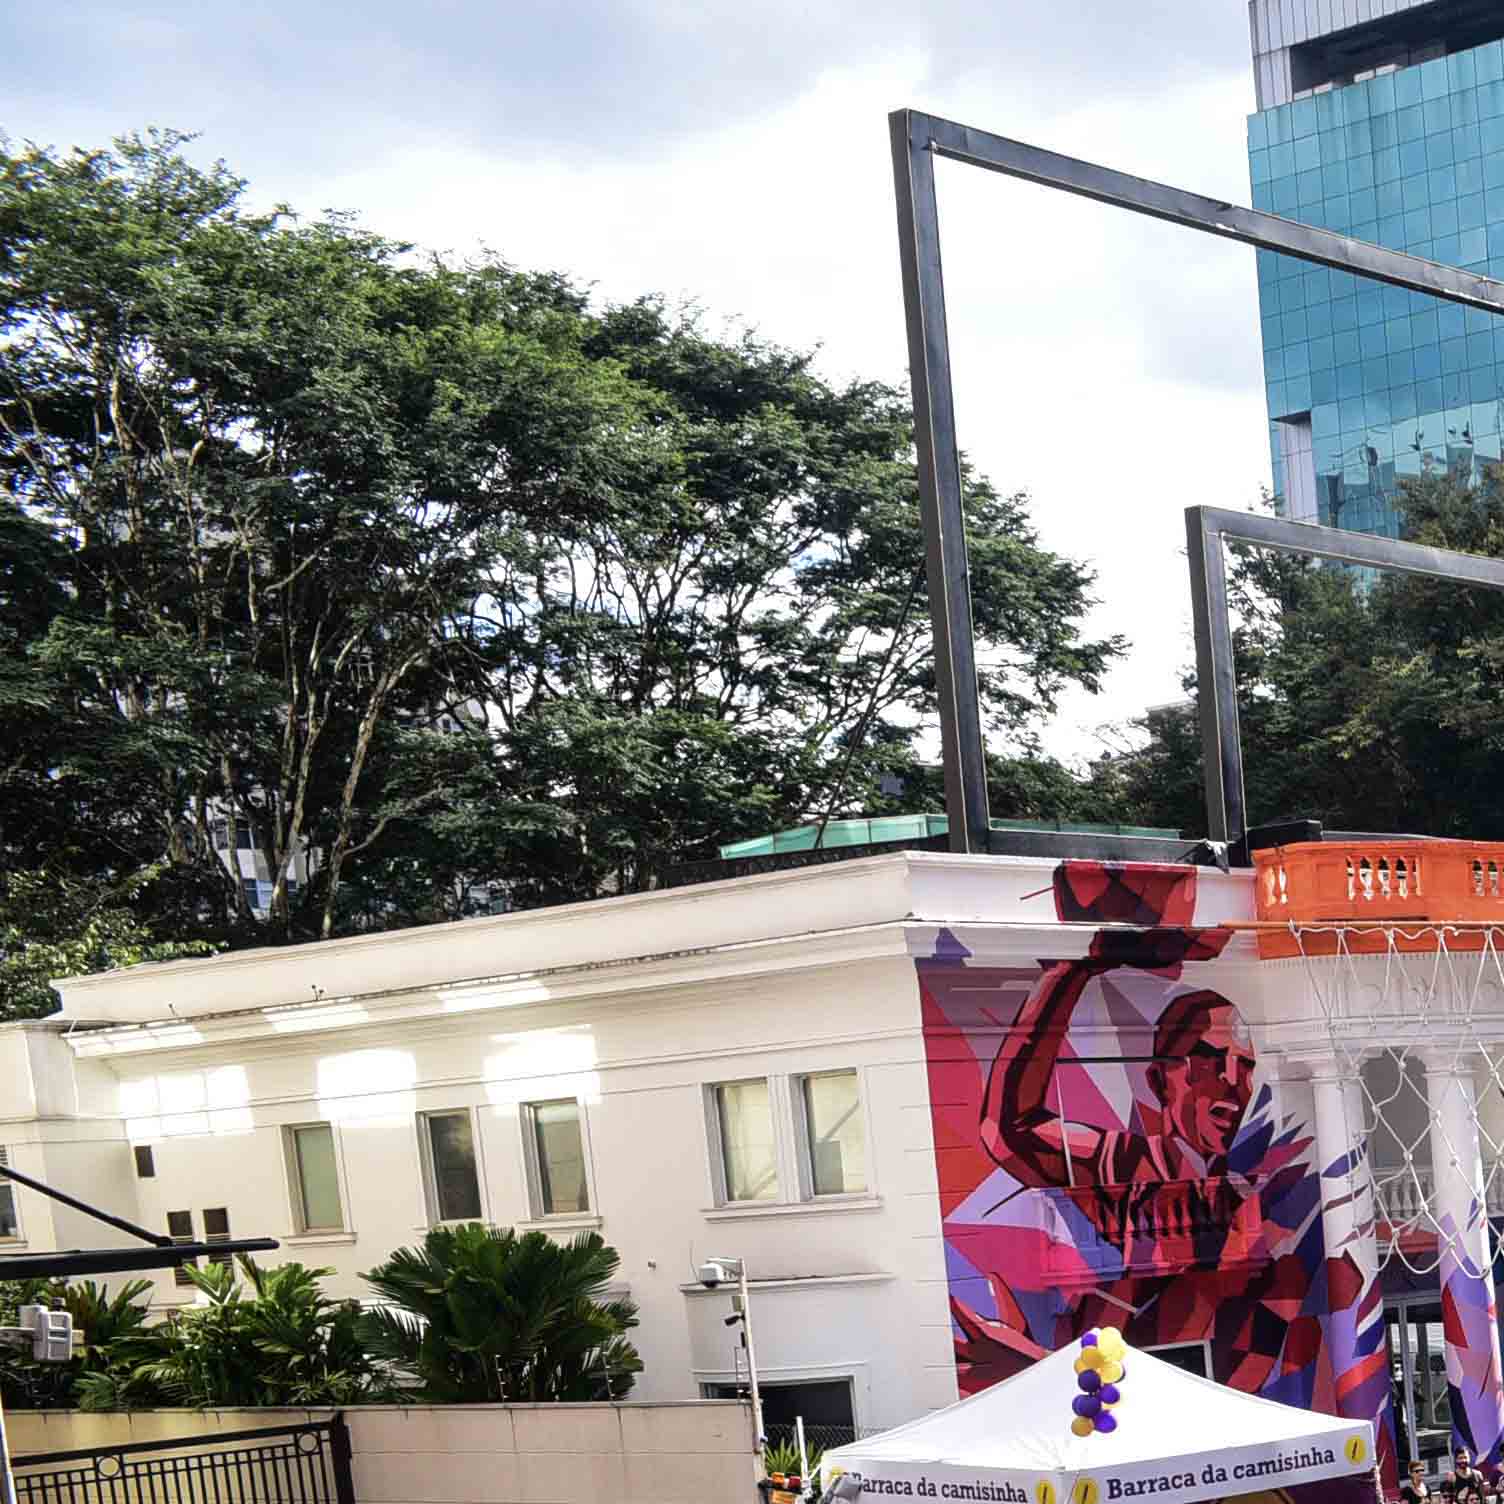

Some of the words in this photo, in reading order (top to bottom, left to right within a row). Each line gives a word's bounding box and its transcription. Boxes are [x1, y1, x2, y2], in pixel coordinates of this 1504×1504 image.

[917, 1477, 938, 1497] da
[941, 1480, 1028, 1503] camisinha
[1106, 1471, 1197, 1500] Barraca
[1201, 1464, 1228, 1485] da
[1233, 1447, 1336, 1480] camisinha
